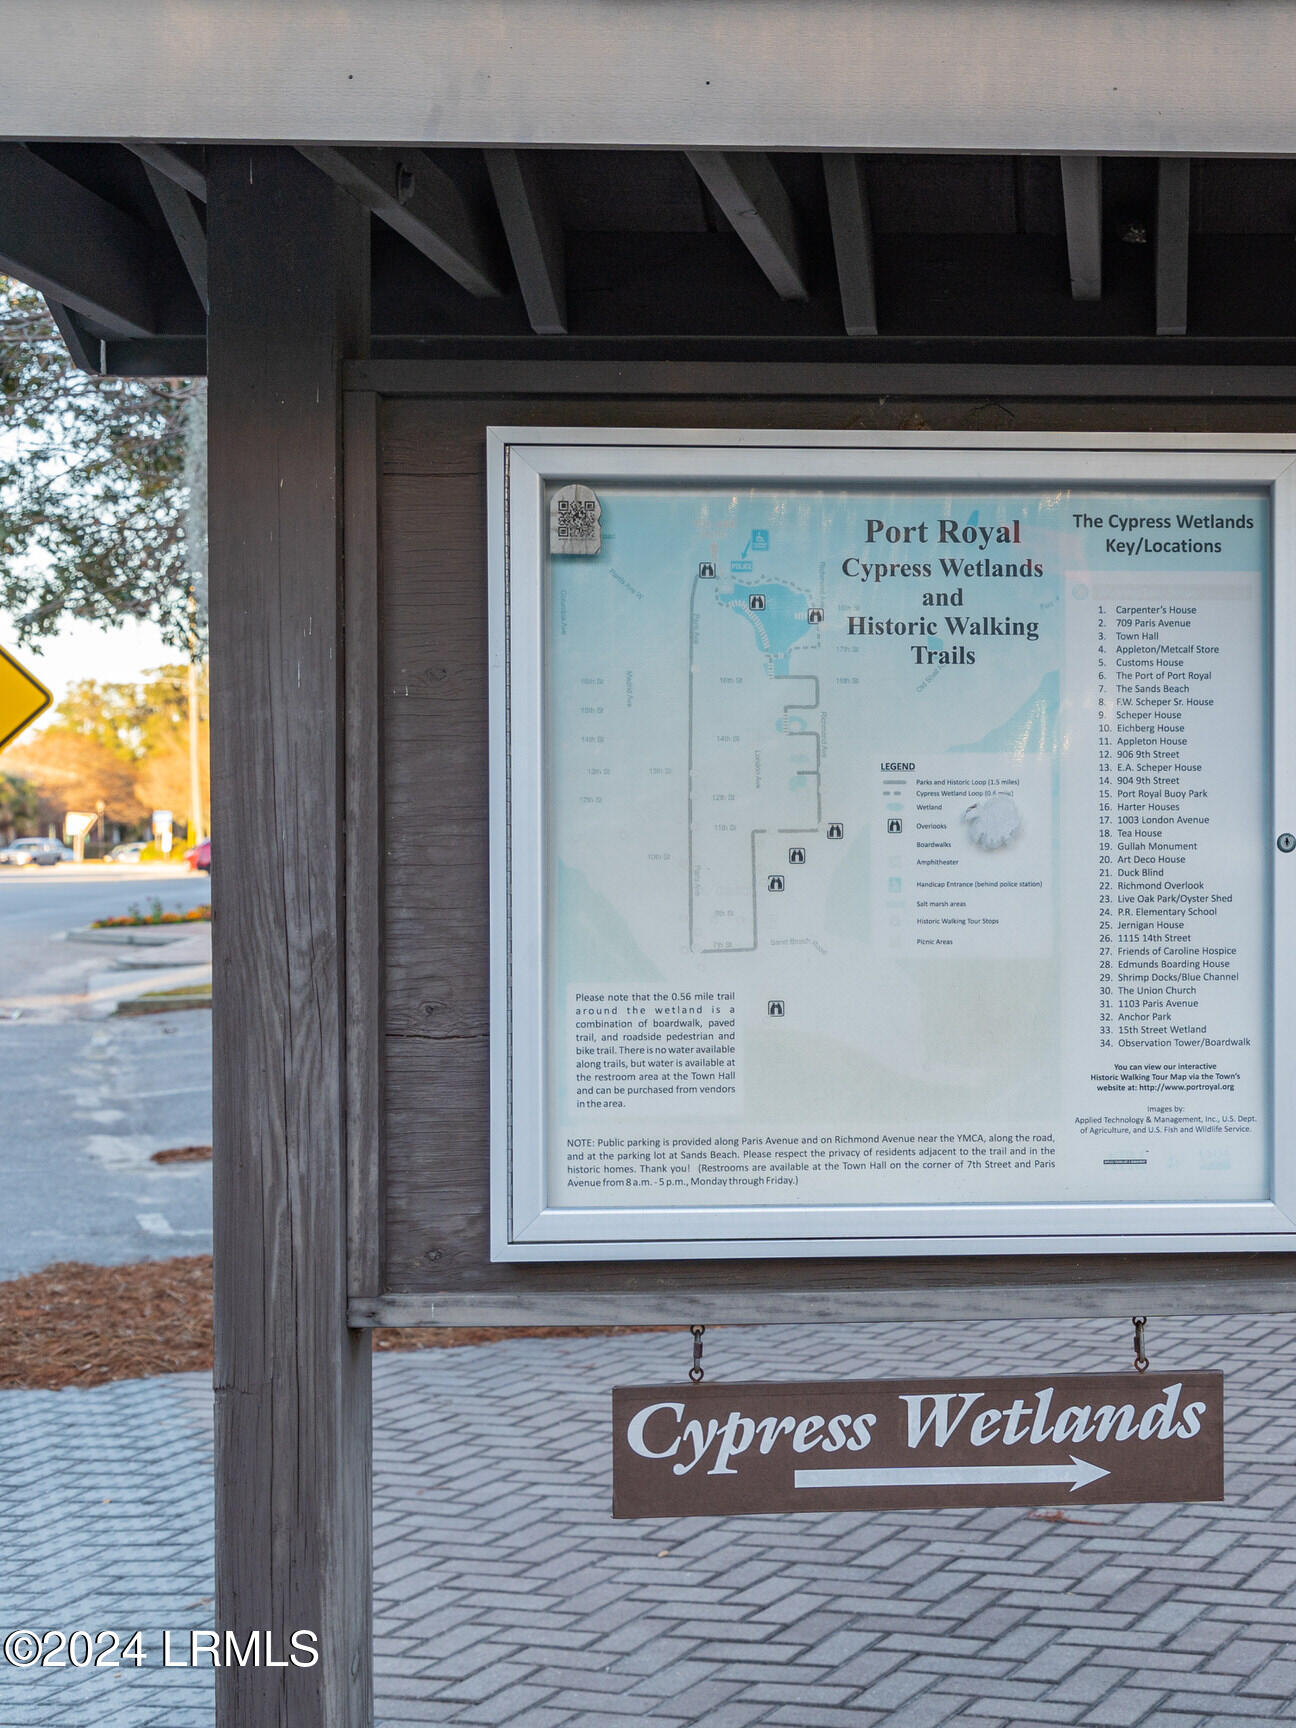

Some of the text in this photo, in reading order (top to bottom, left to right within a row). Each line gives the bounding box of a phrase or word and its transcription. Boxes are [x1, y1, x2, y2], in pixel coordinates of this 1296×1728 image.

[1072, 513, 1254, 532] The Cypress Wetlands
[865, 520, 1021, 550] Port Royal
[1106, 537, 1222, 556] Key/Locations
[842, 558, 1043, 582] Cypress Wetlands
[922, 588, 963, 606] and
[1135, 619, 1156, 627] Paris
[848, 616, 1039, 641] Historic Walking
[1142, 632, 1158, 640] Hall
[1116, 645, 1194, 655] Appleton/Metcalf
[911, 646, 975, 666] Trails
[1098, 671, 1106, 680] 6.
[1116, 671, 1132, 680] The
[1156, 671, 1165, 680] of
[1188, 671, 1211, 681] Royal
[1116, 684, 1132, 693] The
[1134, 684, 1160, 693] Sands
[1163, 684, 1189, 692] Beach
[1098, 698, 1106, 706] 8.
[1136, 698, 1172, 707] Scheper
[1118, 947, 1150, 955] Friends
[1152, 947, 1162, 955] of
[1164, 947, 1200, 955] Caroline
[1202, 946, 1236, 956] Hospice
[1099, 960, 1113, 968] 28.
[1118, 960, 1158, 968] Edmunds
[1161, 960, 1200, 970] Boarding
[1118, 973, 1149, 983] Shrimp
[1152, 973, 1201, 982] Docks/Blue
[1203, 972, 1238, 981] Channel
[1118, 986, 1134, 995] The
[1137, 986, 1163, 994] Union
[1166, 986, 1196, 994] Church
[576, 992, 734, 1002] Please note that the 0.56 mile trail
[1143, 999, 1163, 1008] Paris
[576, 1006, 617, 1015] around
[627, 1006, 646, 1014] the
[655, 1006, 702, 1014] wetland
[712, 1005, 720, 1014] is
[576, 1018, 735, 1029] combination of boardwalk, paved
[1119, 1026, 1138, 1034] 15th
[1170, 1025, 1206, 1034] Wetland
[1118, 1038, 1171, 1047] Observation
[1174, 1038, 1250, 1047] Tower/Boardwalk
[1120, 1073, 1150, 1082] Walking
[1170, 1074, 1187, 1082] Map
[1139, 1083, 1234, 1092] http://www.portroyal.org
[567, 1139, 594, 1147] NOTE:
[598, 1138, 624, 1147] Public
[627, 1138, 660, 1148] parking
[663, 1138, 670, 1146] is
[672, 1137, 711, 1147] provided
[714, 1137, 739, 1147] along
[742, 1136, 763, 1145] Paris
[802, 1136, 818, 1144] and
[835, 1135, 879, 1144] Richmond
[882, 1135, 915, 1143] Avenue
[940, 1134, 954, 1143] the
[957, 1134, 986, 1144] YMCA,
[989, 1133, 1013, 1144] along
[1015, 1133, 1030, 1142] the
[1033, 1133, 1055, 1143] road,
[627, 1382, 1207, 1476] Cypress Wetlands
